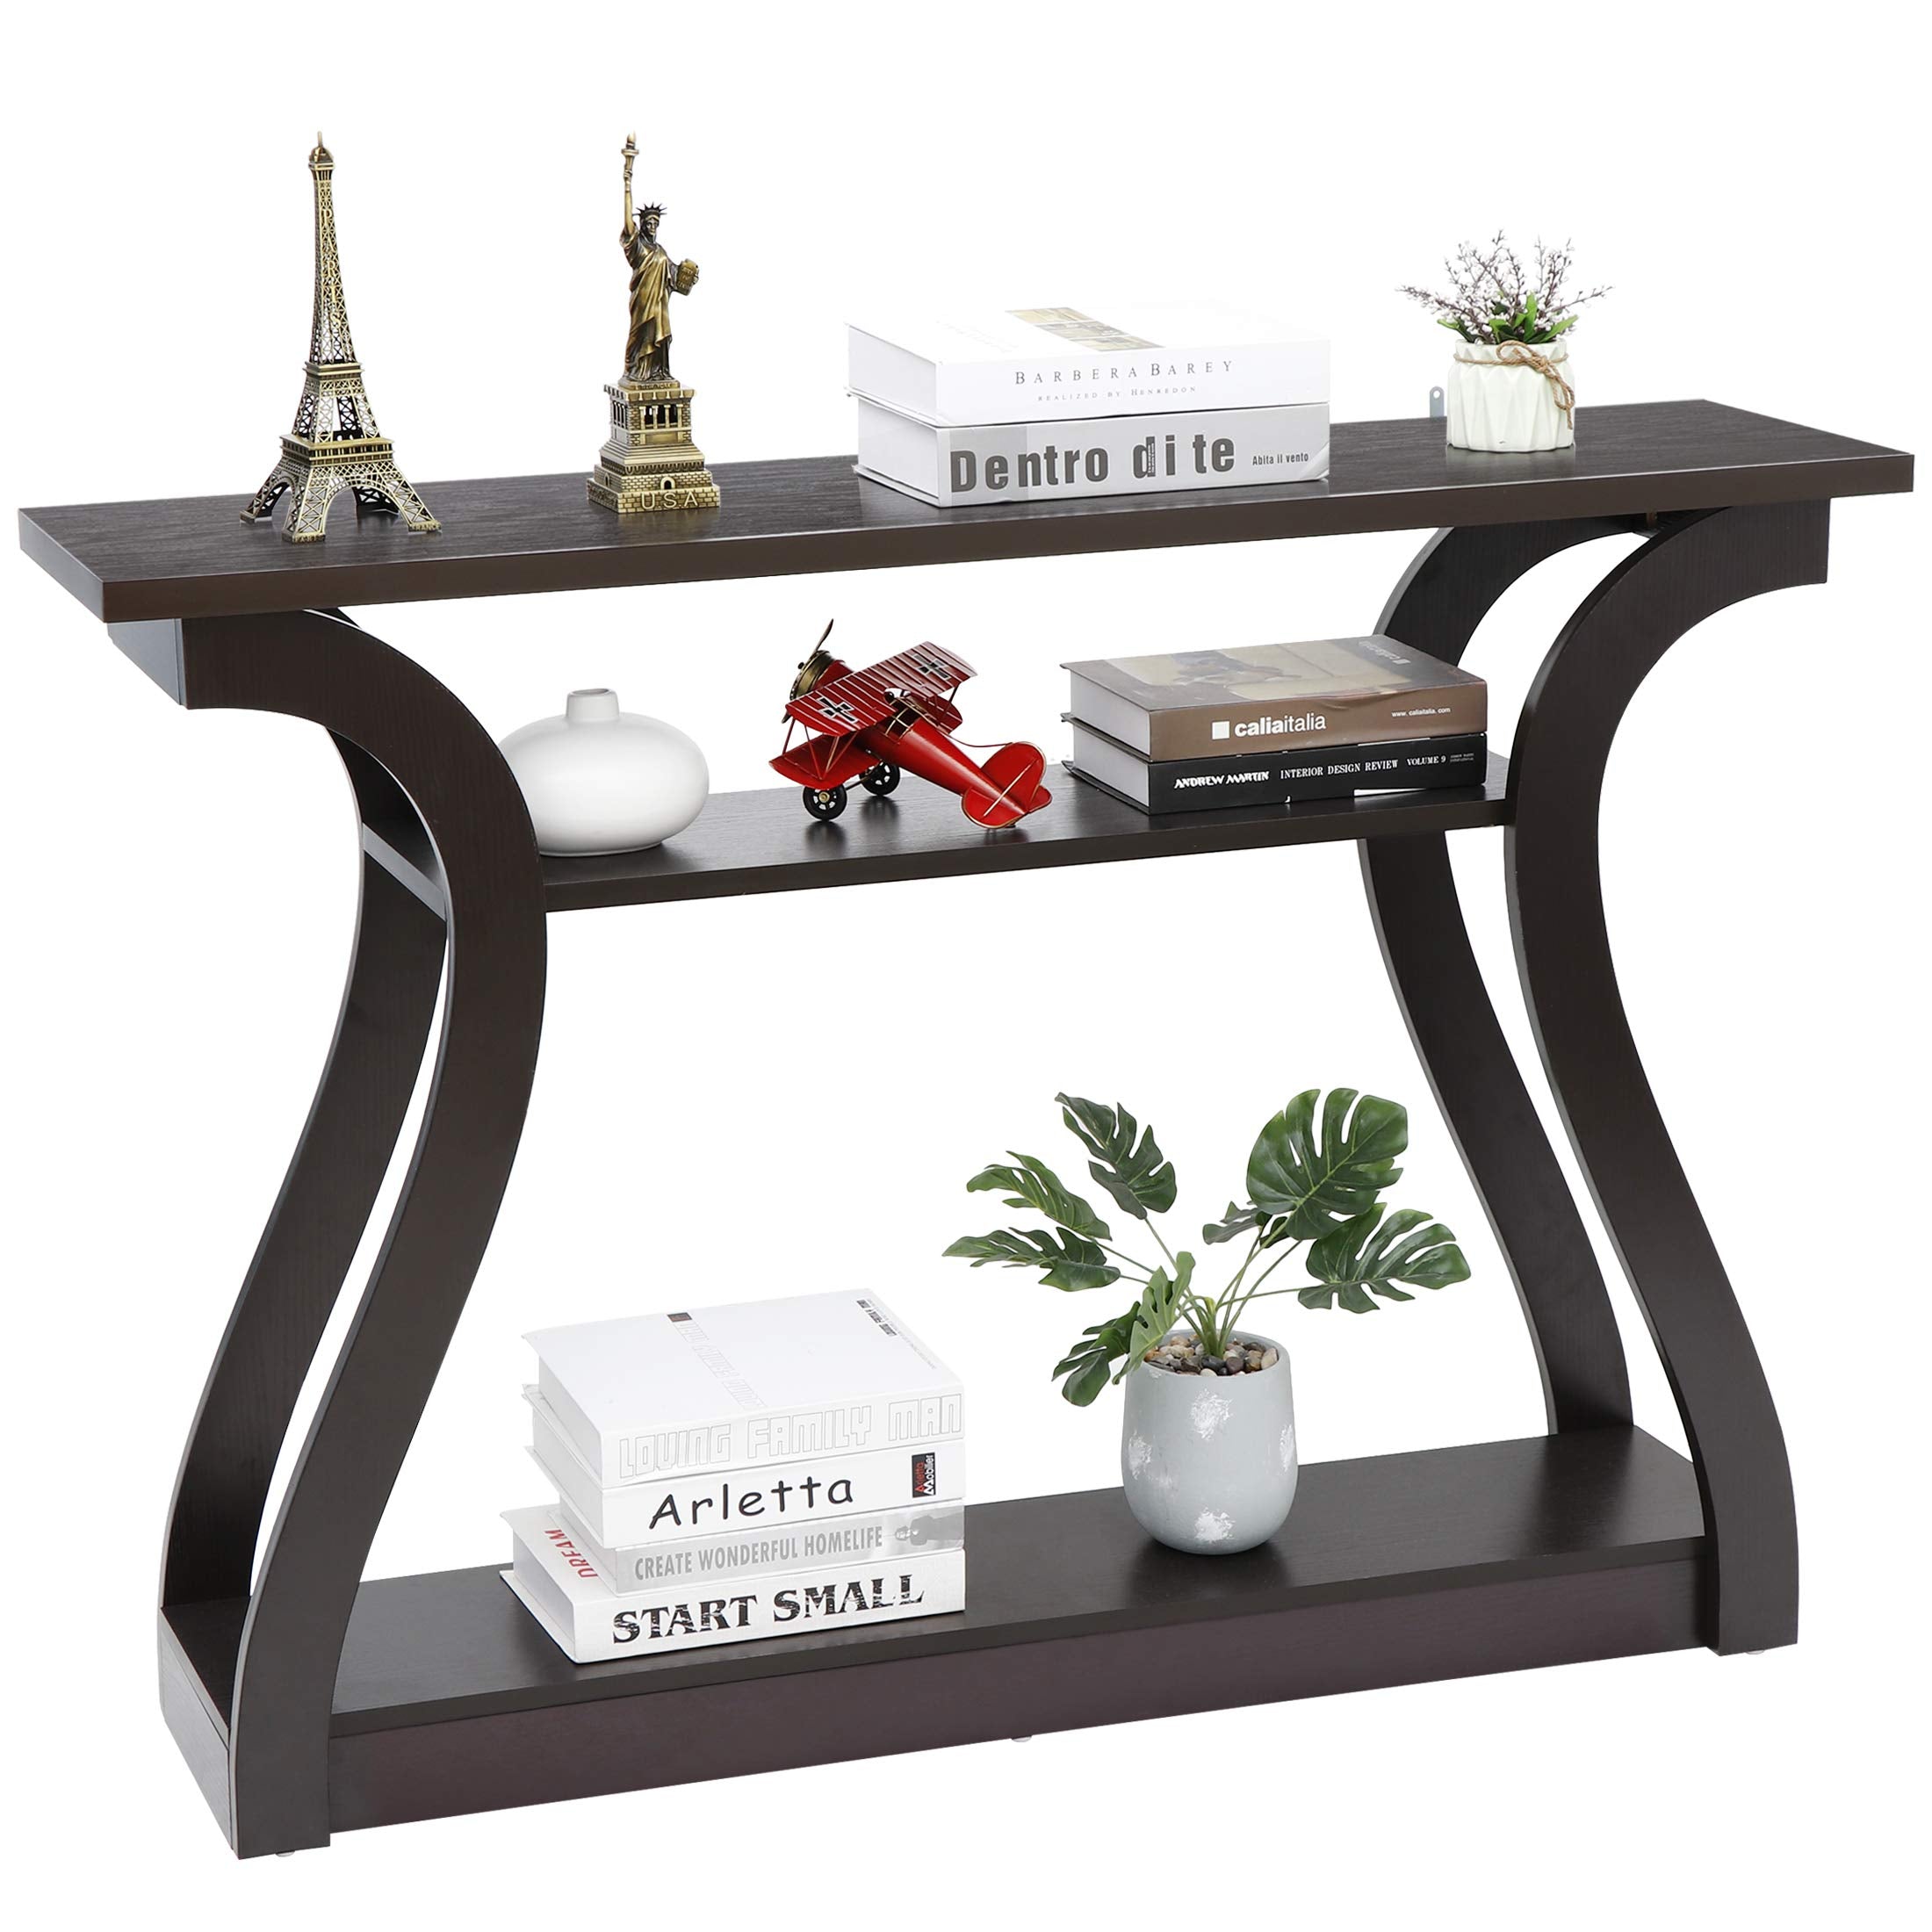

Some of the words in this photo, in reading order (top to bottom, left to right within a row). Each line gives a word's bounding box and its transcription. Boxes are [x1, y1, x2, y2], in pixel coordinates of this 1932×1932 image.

[1015, 366, 1137, 385] BARBERA
[1150, 360, 1231, 377] BAREY
[1038, 393, 1098, 401] REALIZED
[950, 444, 1108, 493] Dentro
[1133, 435, 1176, 479] di
[1192, 434, 1235, 473] te
[1252, 455, 1274, 465] Abita
[1277, 454, 1283, 464] il
[1286, 452, 1309, 463] vento
[1235, 712, 1327, 737] caliaitalia
[1174, 775, 1225, 789] ANDREW
[1225, 770, 1270, 784] MARTIN
[1280, 767, 1323, 780] INTERIOR
[1327, 762, 1361, 775] DESIGN
[1365, 759, 1398, 771] REVIEW
[1407, 755, 1438, 766] VOLUME
[620, 1424, 731, 1478] LOVING
[747, 1406, 871, 1459] FAMILY
[889, 1394, 962, 1441] MAN
[649, 1476, 854, 1530] Arletta
[635, 1552, 692, 1581] CREATE
[698, 1538, 798, 1571] WONDERFUL
[804, 1525, 883, 1556] HOMELIFE
[613, 1595, 758, 1644] START
[773, 1575, 925, 1623] SMALL
